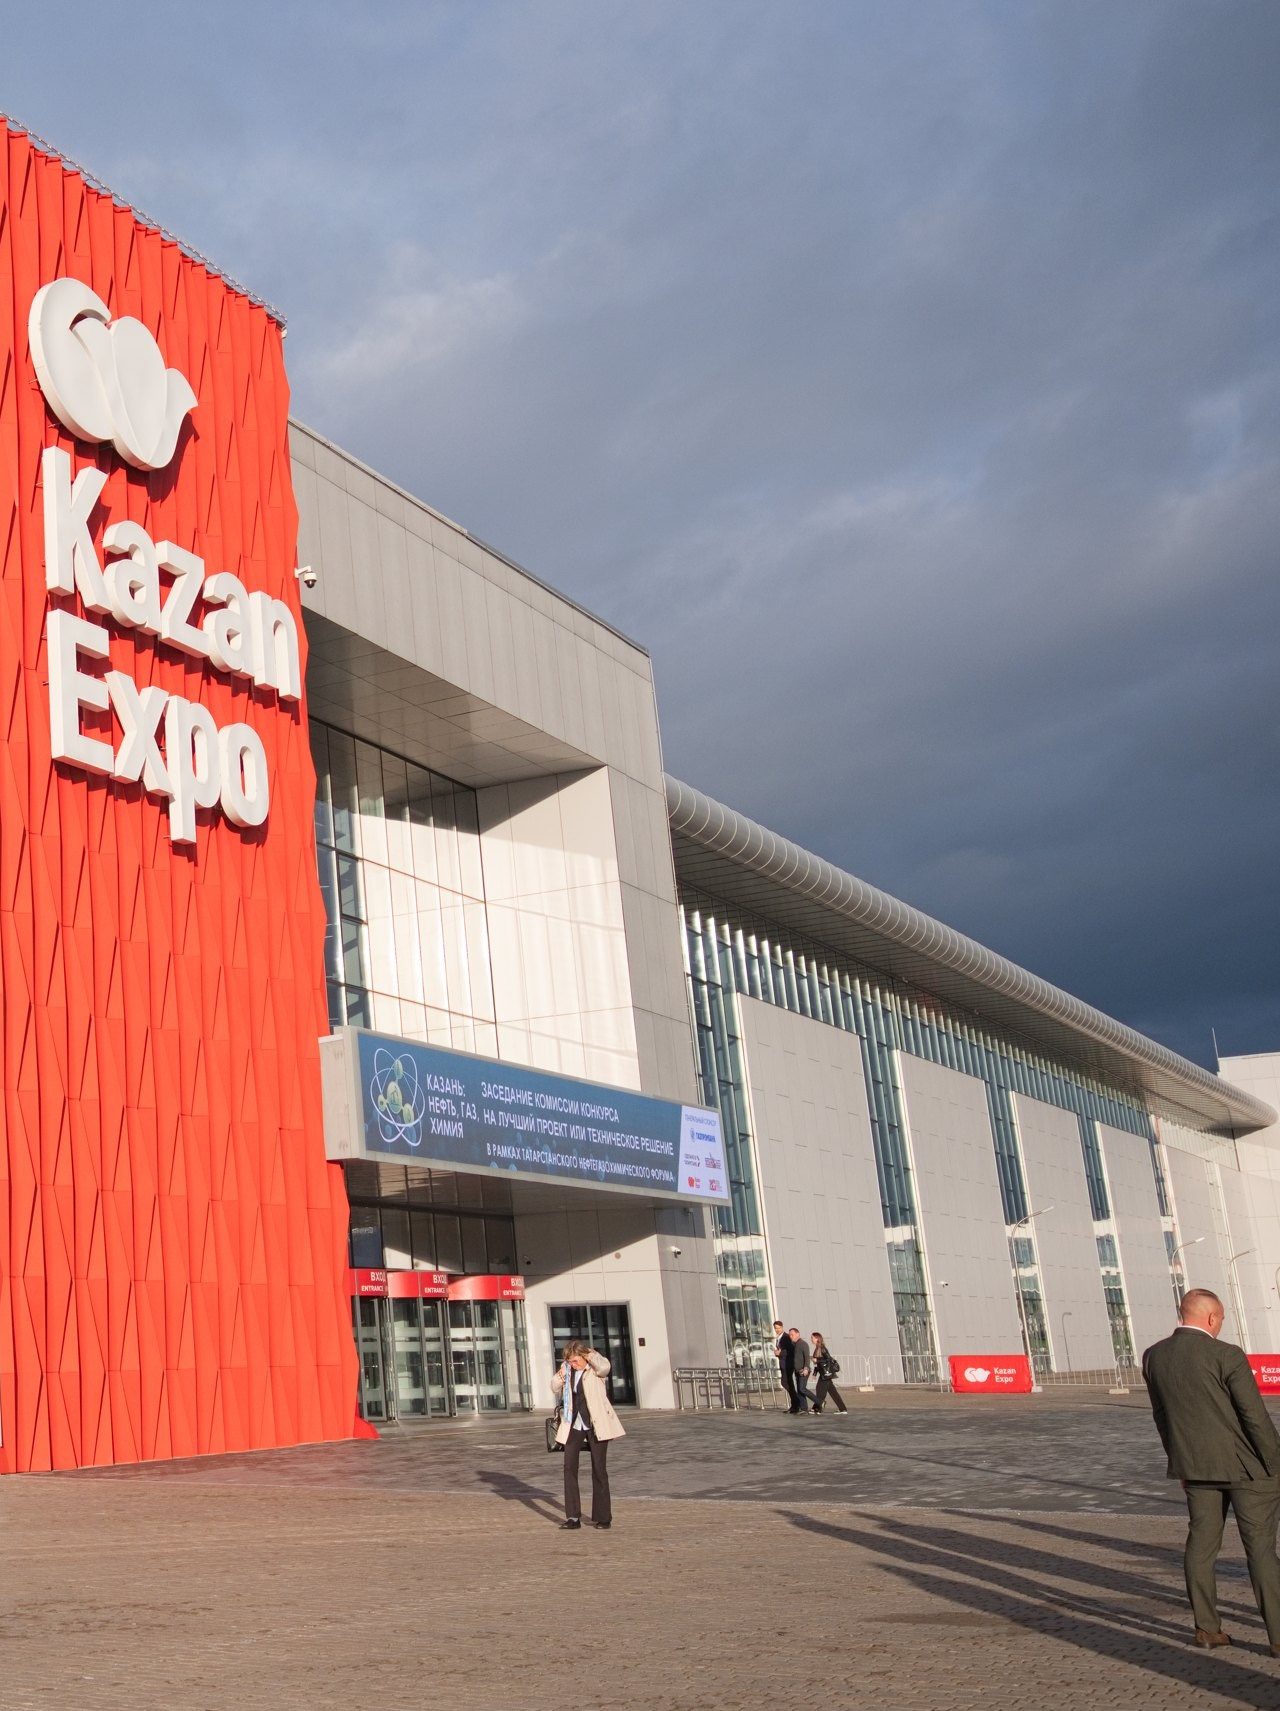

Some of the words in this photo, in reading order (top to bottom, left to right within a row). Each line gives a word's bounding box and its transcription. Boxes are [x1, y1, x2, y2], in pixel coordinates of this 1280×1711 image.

[43, 446, 302, 701] Kazan
[46, 609, 269, 845] Expo
[426, 1074, 466, 1097] КАЗАНЬ:
[428, 1096, 459, 1119] НЕФТЬ,
[460, 1101, 480, 1122] ГАЗ,
[481, 1082, 533, 1106] ЗАСЕДАНИЕ
[535, 1093, 580, 1115] КОМИССИИ
[581, 1102, 620, 1123] КОНКУРСА
[430, 1118, 464, 1138] ХИМИЯ
[483, 1109, 497, 1125] НА
[499, 1112, 535, 1132] ЛУЧШИЙ
[537, 1119, 568, 1138] ПРОЕКТ
[570, 1125, 587, 1141] ИЛИ
[587, 1128, 640, 1150] ТЕХНИЧЕСКОЕ
[640, 1137, 674, 1156] РЕШЕНИЕ
[486, 1143, 492, 1155] В
[493, 1144, 521, 1160] РАМКАХ
[521, 1148, 578, 1169] ТАТАРСТАНСКОГО
[651, 1168, 674, 1182] ФОРУМА
[993, 1367, 1017, 1375] Kazan
[995, 1376, 1014, 1384] Expo
